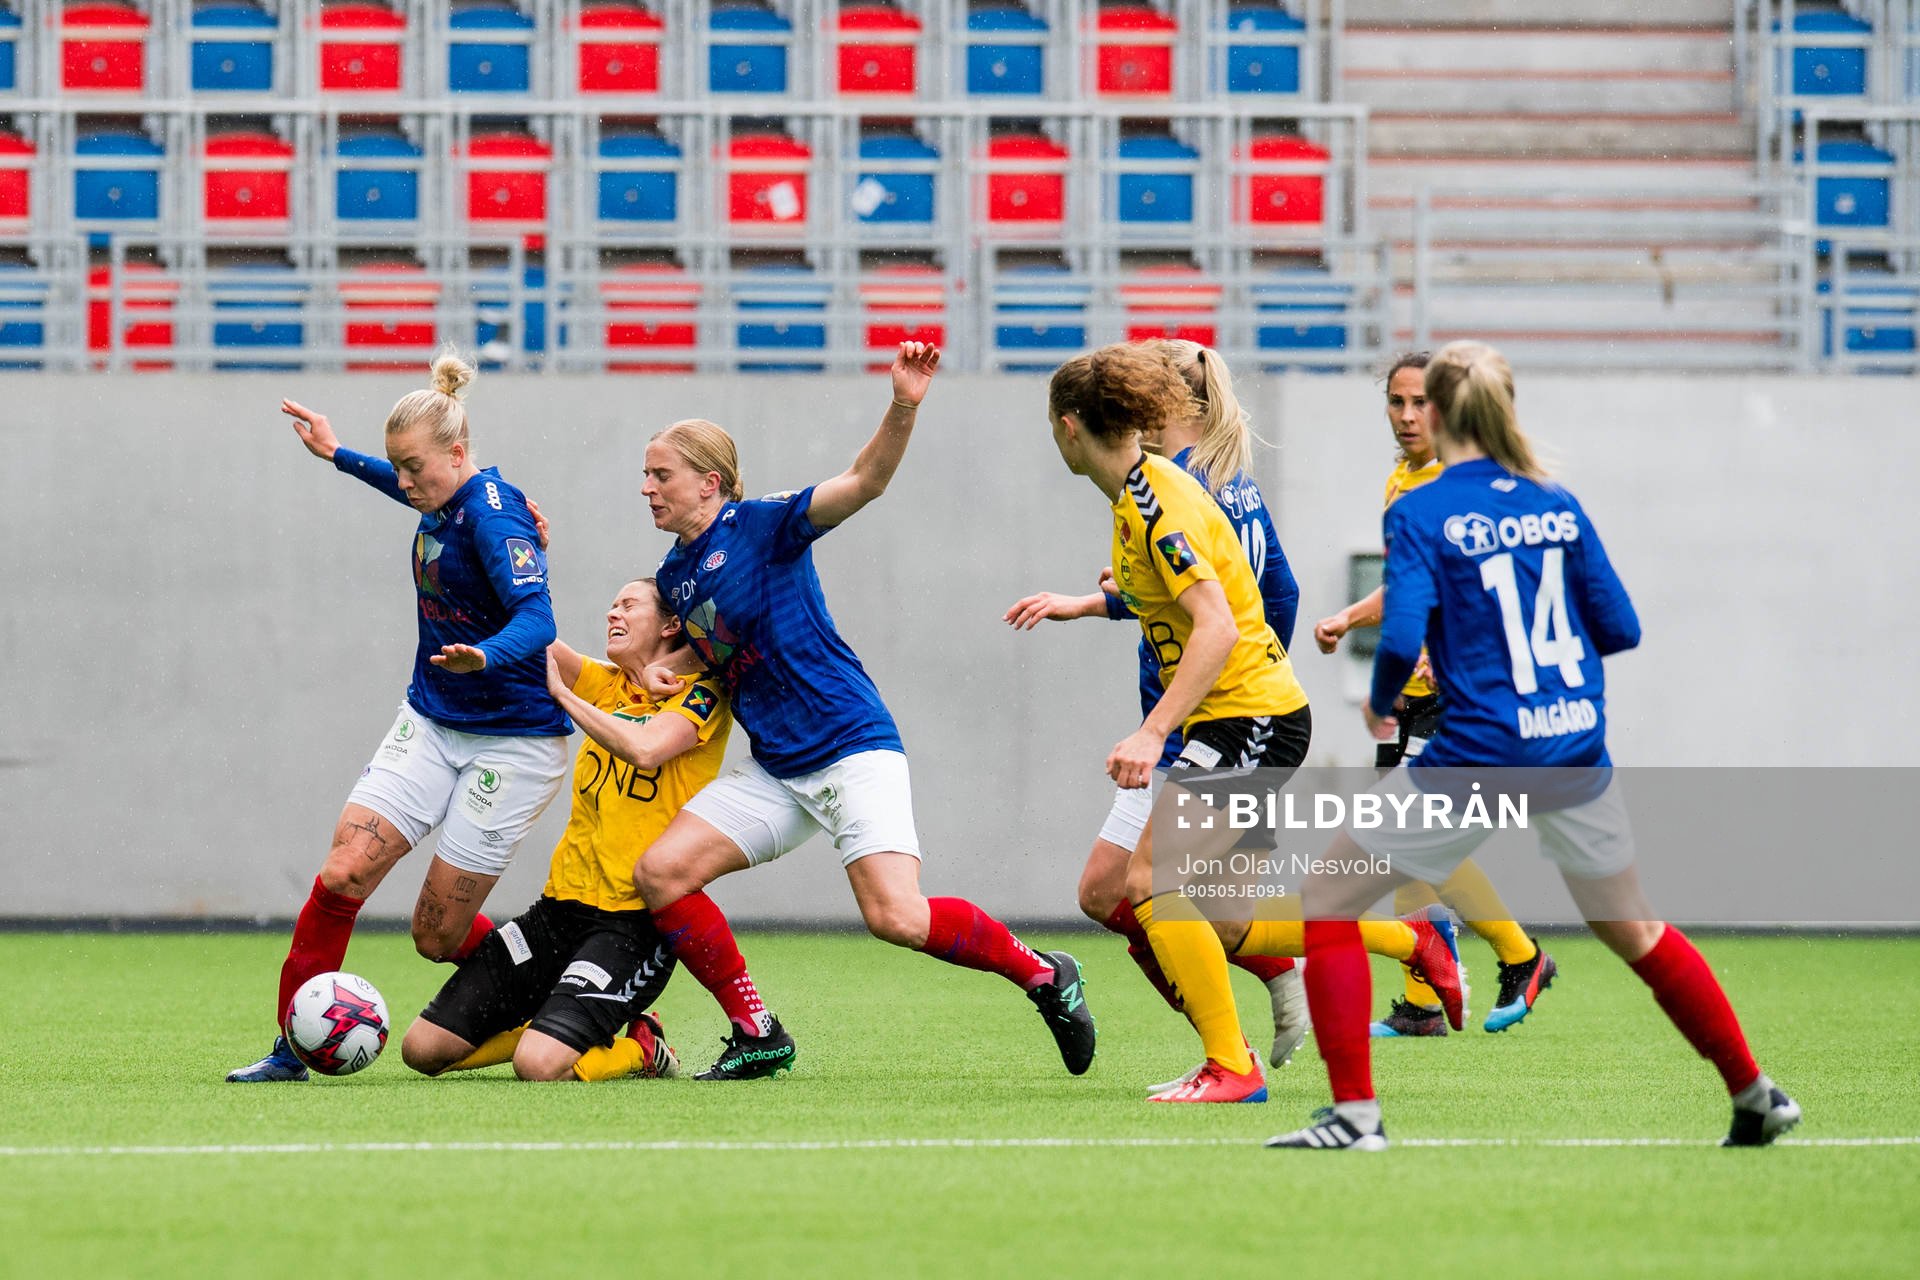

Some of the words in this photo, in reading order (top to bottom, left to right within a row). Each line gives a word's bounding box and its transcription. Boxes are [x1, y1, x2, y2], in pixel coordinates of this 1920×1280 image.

[1498, 510, 1580, 548] OBOS
[1479, 547, 1586, 695] 14
[1517, 696, 1598, 739] DALGÅRD
[720, 1056, 743, 1072] new
[743, 1045, 792, 1064] balance
